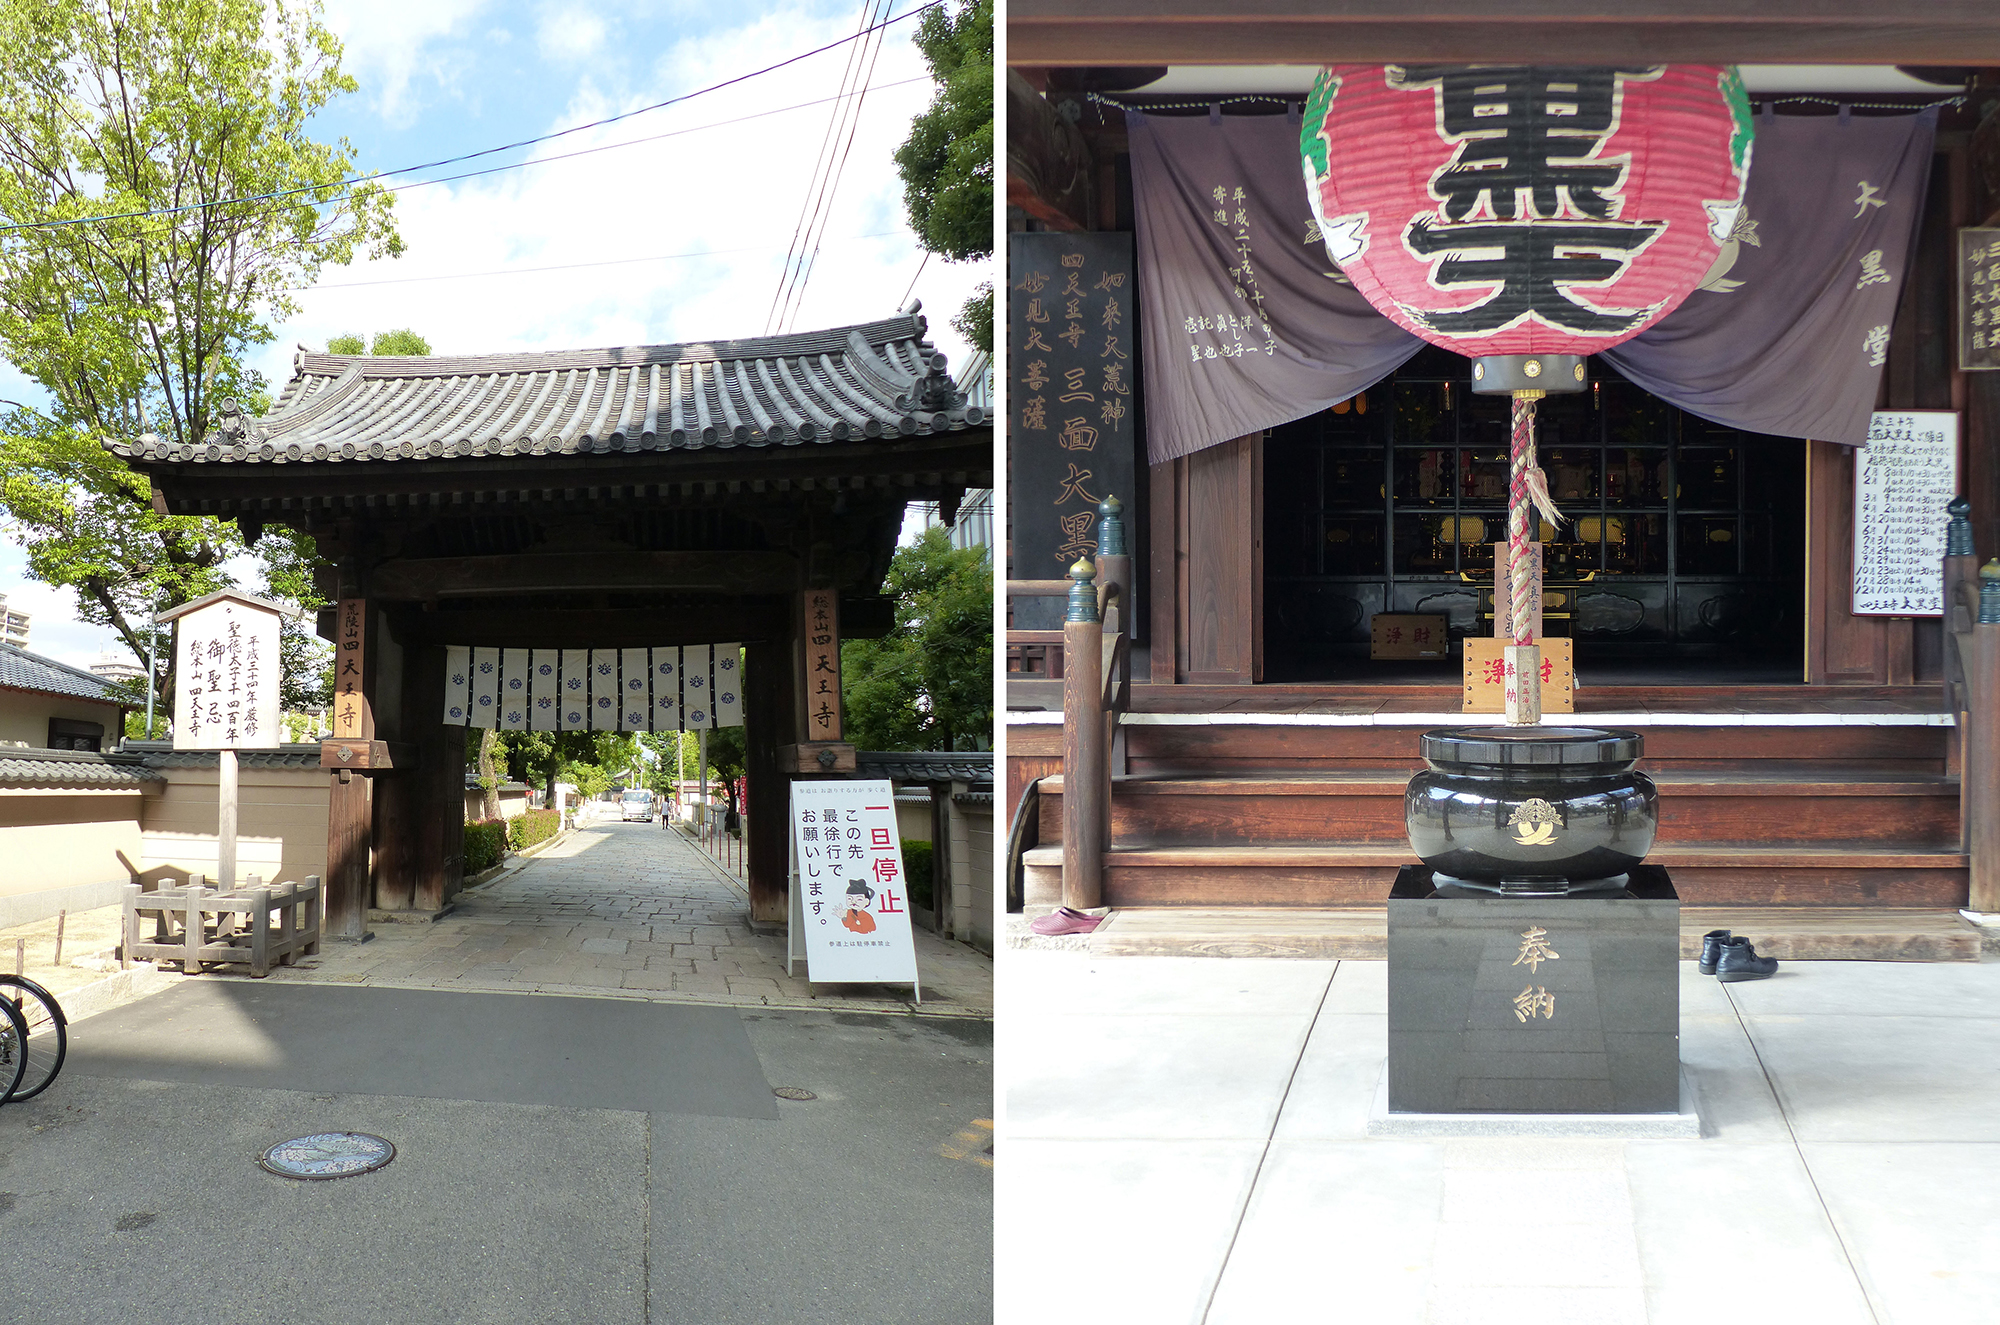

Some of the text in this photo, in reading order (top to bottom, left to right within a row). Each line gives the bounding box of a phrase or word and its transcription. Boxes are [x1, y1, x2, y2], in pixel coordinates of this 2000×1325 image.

[1213, 185, 1229, 226] 寄進
[1385, 64, 1668, 338] 黒天
[1854, 180, 1893, 368] 大黒堂
[1968, 247, 1988, 350] 妙見大菩薩
[1015, 271, 1052, 431] 妙見大菩薩
[1228, 313, 1245, 358] とし子
[1870, 415, 1914, 428] 成三十年
[1900, 596, 1944, 611] 大黒堂
[188, 639, 204, 738] 総本山四天王寺
[206, 638, 226, 724] 御聖忌
[225, 620, 243, 744] 聖徳太子千四百年
[811, 595, 837, 729] 総本山四天王寺
[1505, 661, 1517, 704] 奉納
[801, 808, 828, 926] お願いします。
[822, 808, 844, 878] 最徐行で
[845, 808, 865, 860] この先
[864, 805, 905, 914] 一旦停止
[1512, 924, 1560, 1023] 奉納
